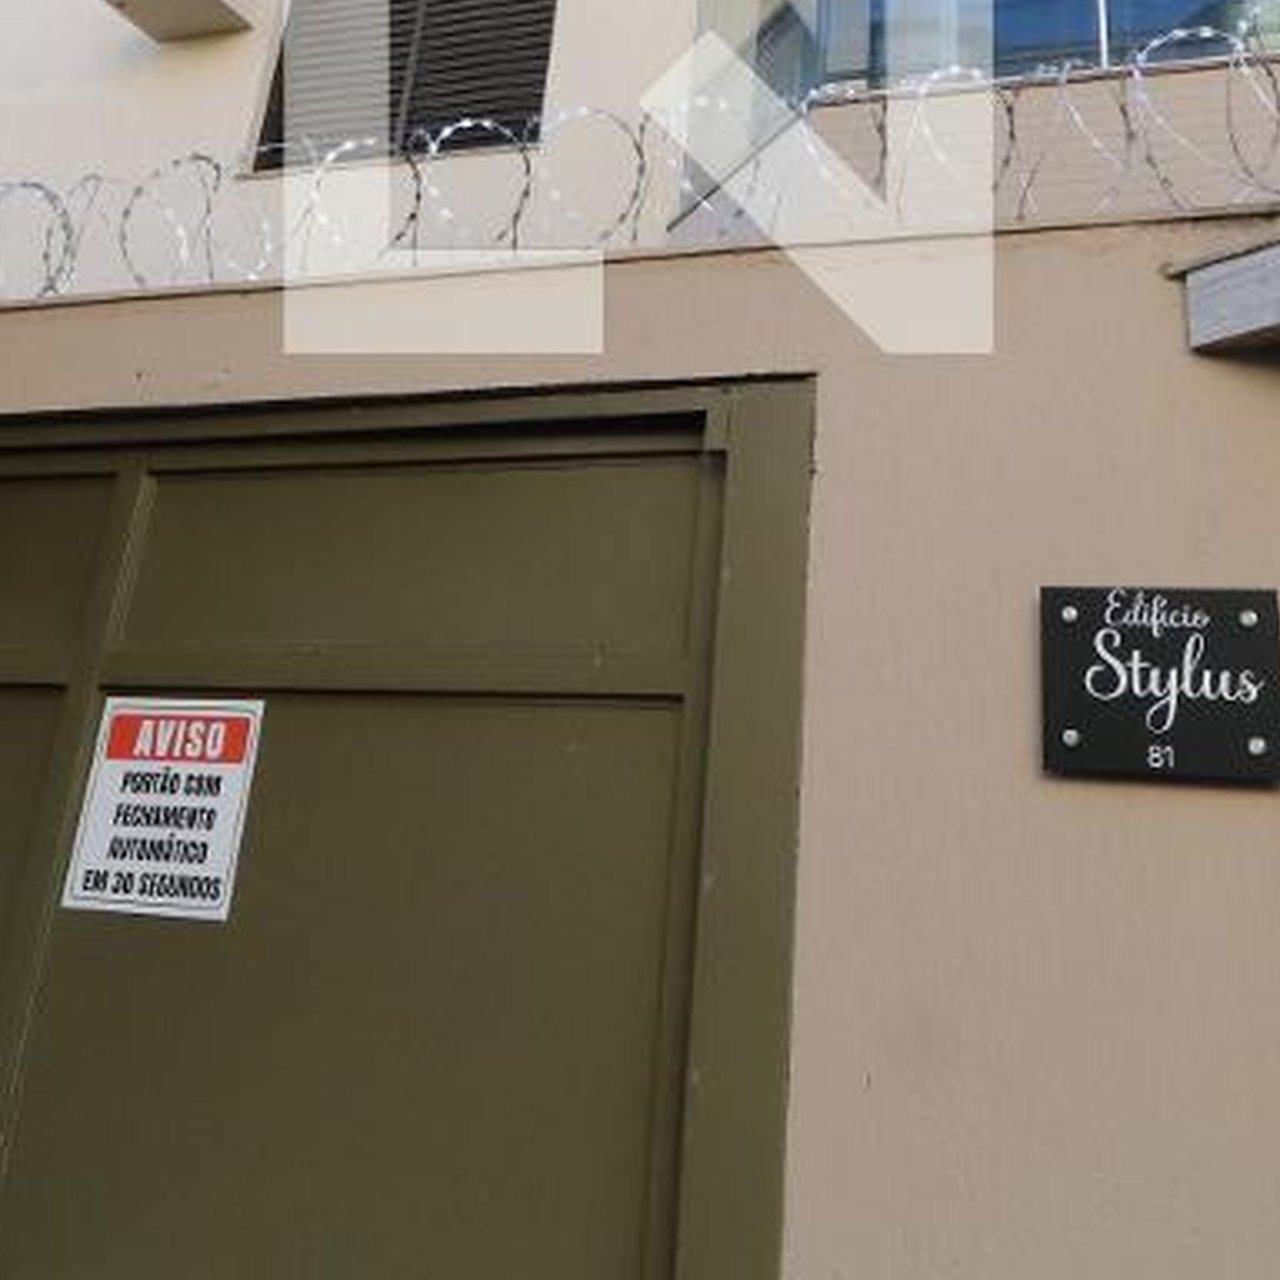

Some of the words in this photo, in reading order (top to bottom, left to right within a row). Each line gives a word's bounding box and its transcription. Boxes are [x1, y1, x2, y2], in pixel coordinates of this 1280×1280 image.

[1084, 627, 1265, 734] Stylus
[133, 719, 225, 757] AVISO
[1146, 745, 1175, 769] 81
[120, 767, 180, 794] PORTÃO
[184, 775, 222, 796] COM
[112, 803, 217, 831] FECHAMENTO
[106, 832, 209, 864] AUTOMÁTICO
[82, 869, 108, 891] EM
[137, 873, 222, 900] SEGUNDOS
